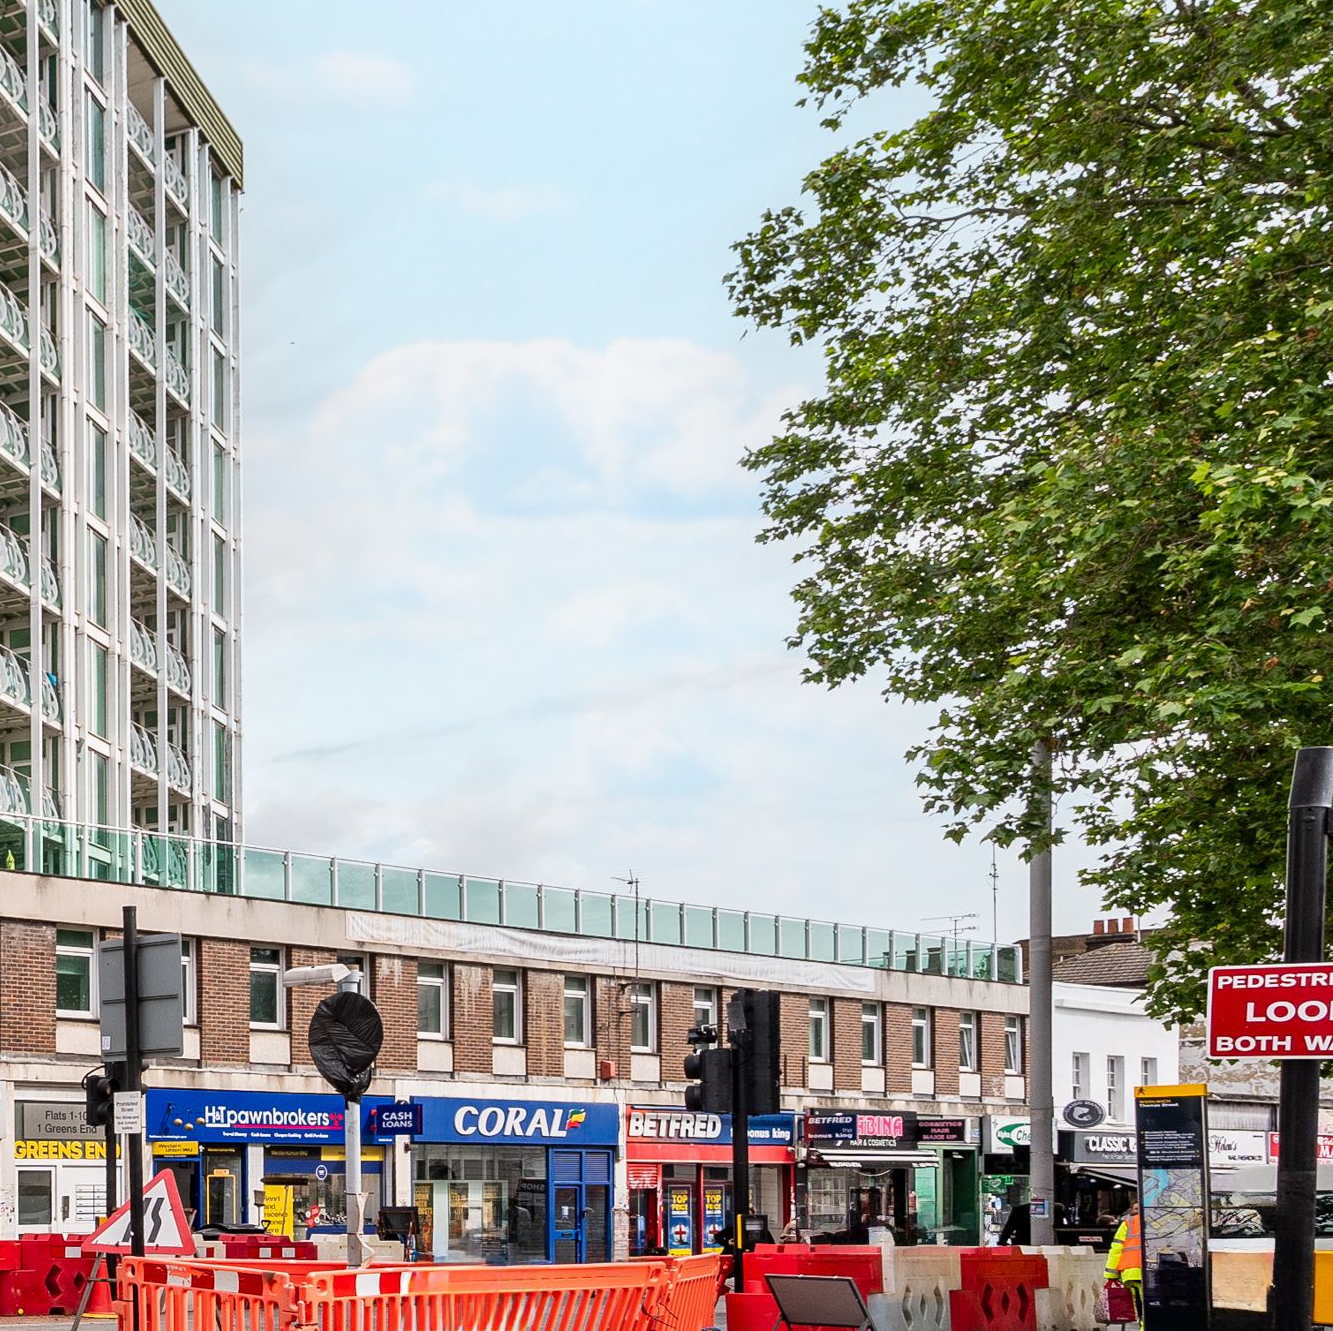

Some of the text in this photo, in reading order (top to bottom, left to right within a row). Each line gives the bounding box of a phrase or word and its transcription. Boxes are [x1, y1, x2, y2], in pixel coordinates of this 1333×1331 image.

[1218, 972, 1333, 989] PEDESTRI
[1216, 1035, 1292, 1051] BOTH
[45, 1110, 66, 1120] Flats
[383, 1111, 412, 1120] CASH
[808, 1116, 852, 1124] BETFRED
[454, 1106, 567, 1138] CORAL
[628, 1112, 722, 1139] BETFRED
[44, 1124, 78, 1133] Greens
[79, 1124, 97, 1133] End
[772, 1127, 790, 1140] king
[868, 1139, 897, 1147] COSMETICS
[1088, 1136, 1127, 1152] CLASSIC
[14, 1140, 83, 1159] GREENS
[672, 1195, 688, 1203] TOP
[705, 1195, 721, 1203] TOP
